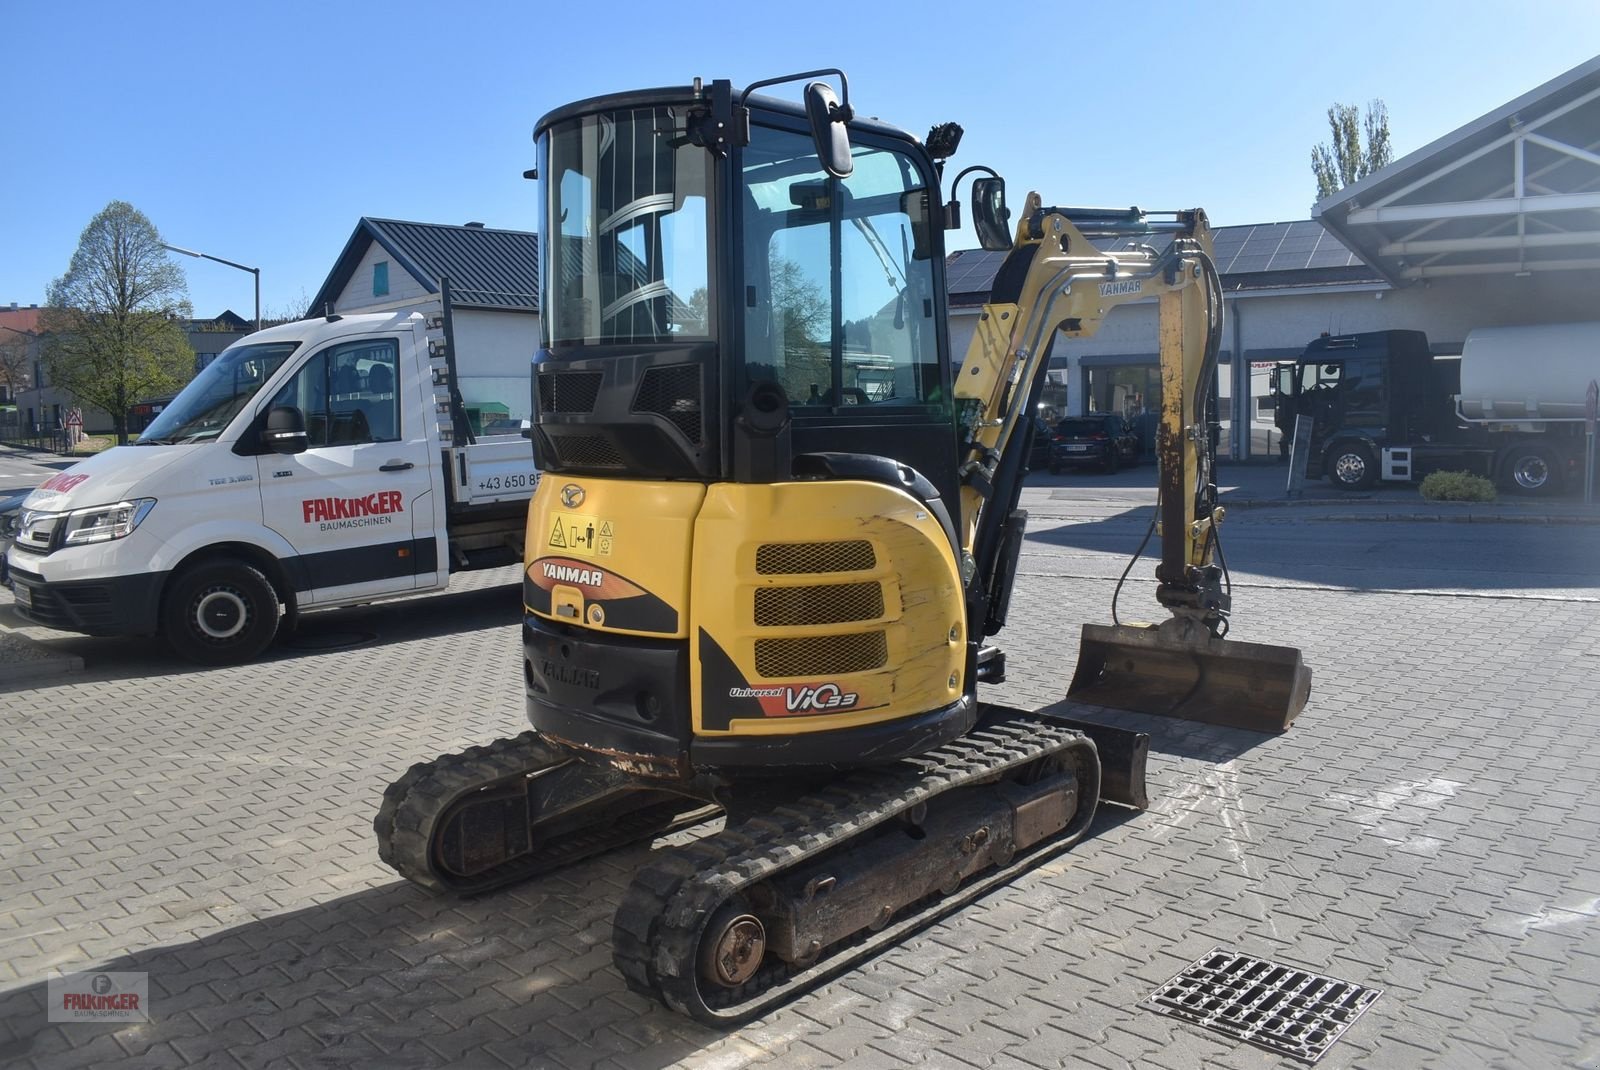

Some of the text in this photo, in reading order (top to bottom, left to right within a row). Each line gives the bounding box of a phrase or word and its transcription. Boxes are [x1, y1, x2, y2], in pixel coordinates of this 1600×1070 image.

[1099, 281, 1141, 297] YANMAR
[479, 477, 501, 490] +43
[504, 475, 525, 488] 650
[302, 490, 404, 523] FALKINGER
[320, 516, 392, 531] BAUMASCHINEN
[542, 562, 602, 587] YANMAR
[729, 687, 784, 698] Universal
